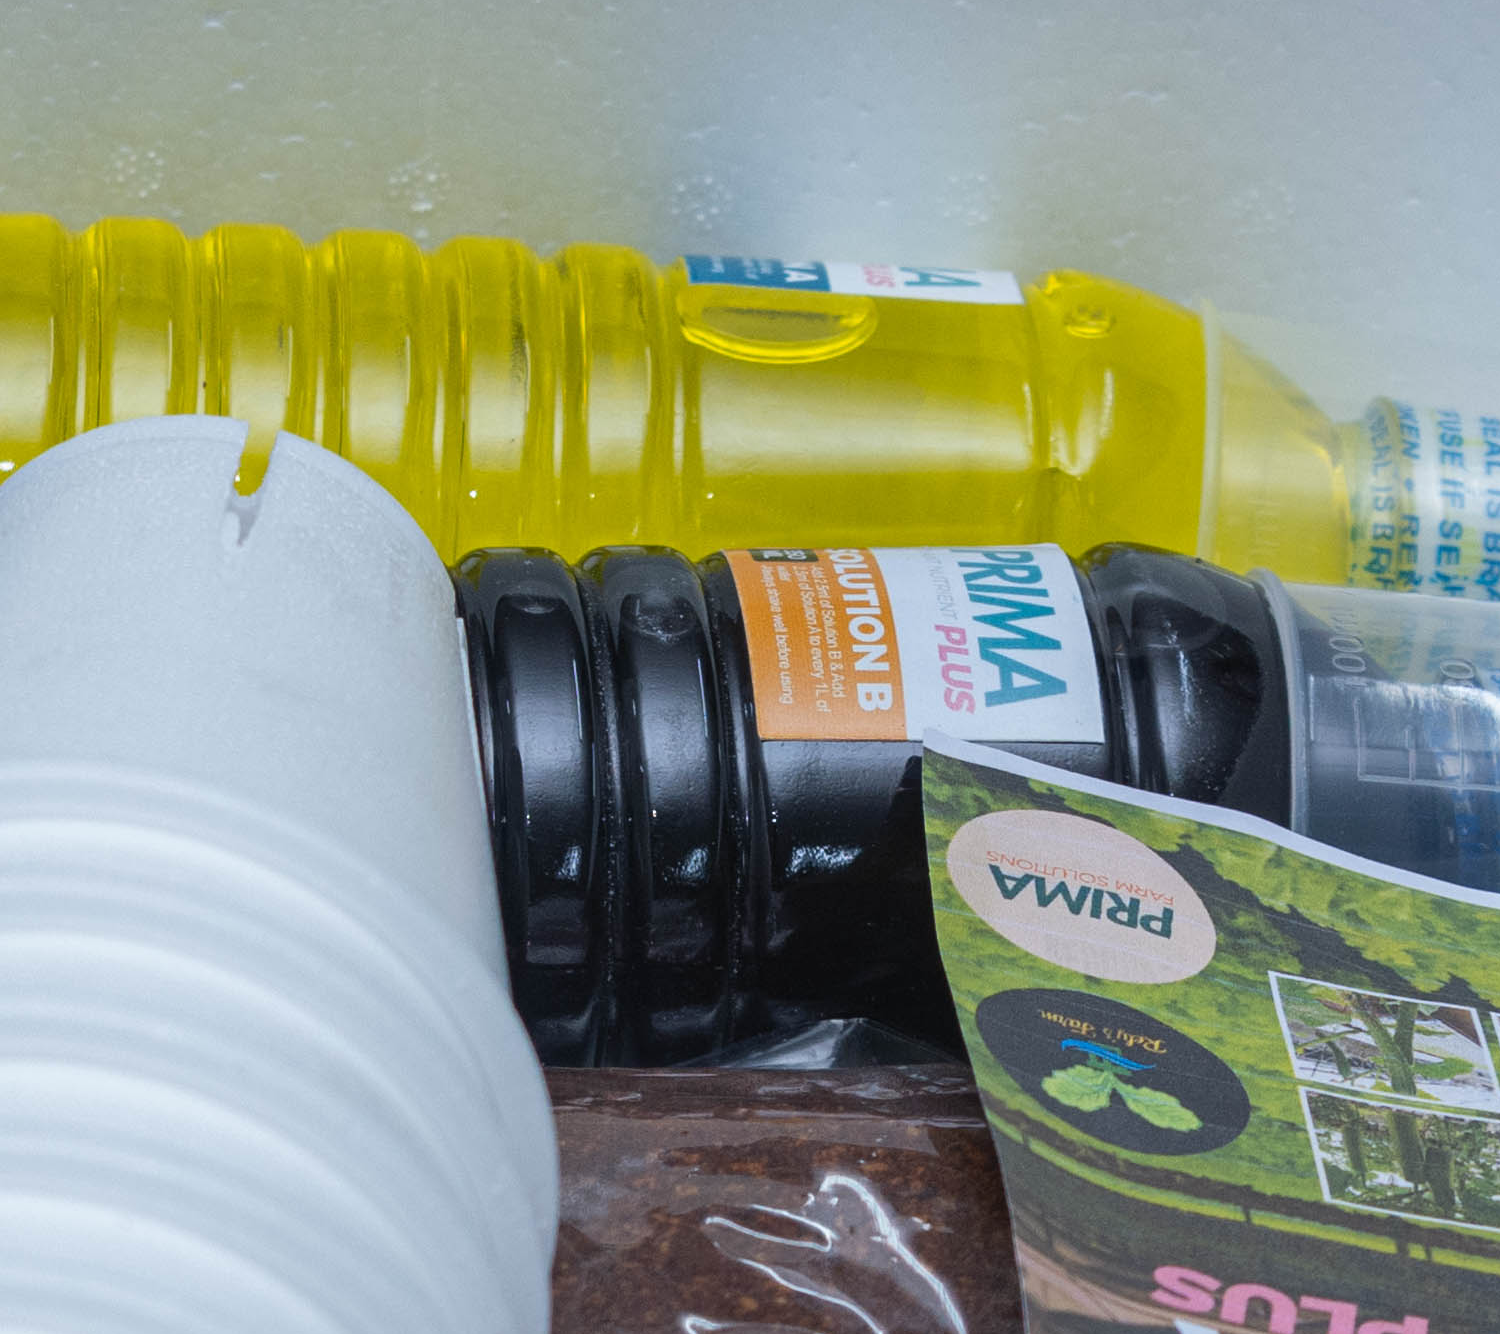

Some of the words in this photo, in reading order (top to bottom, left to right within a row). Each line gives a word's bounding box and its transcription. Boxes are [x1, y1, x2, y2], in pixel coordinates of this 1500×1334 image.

[766, 588, 782, 612] shake
[800, 591, 816, 624] Solution
[825, 548, 890, 671] SOLUTION
[772, 614, 788, 633] well
[807, 625, 821, 634] A
[821, 610, 840, 648] Solution
[952, 550, 1067, 708] PRIMA
[775, 634, 791, 668] before
[809, 635, 821, 646] to
[829, 651, 842, 659] B
[810, 647, 825, 679] every
[830, 662, 844, 670] &
[935, 624, 975, 714] PLUS
[779, 671, 794, 705] using
[815, 683, 829, 699] 1L
[832, 671, 847, 698] Add
[856, 682, 893, 713] B
[815, 700, 832, 713] of
[986, 850, 1109, 887] SOLUTIONS
[989, 863, 1174, 939] PRIMA
[1116, 880, 1175, 906] FARM
